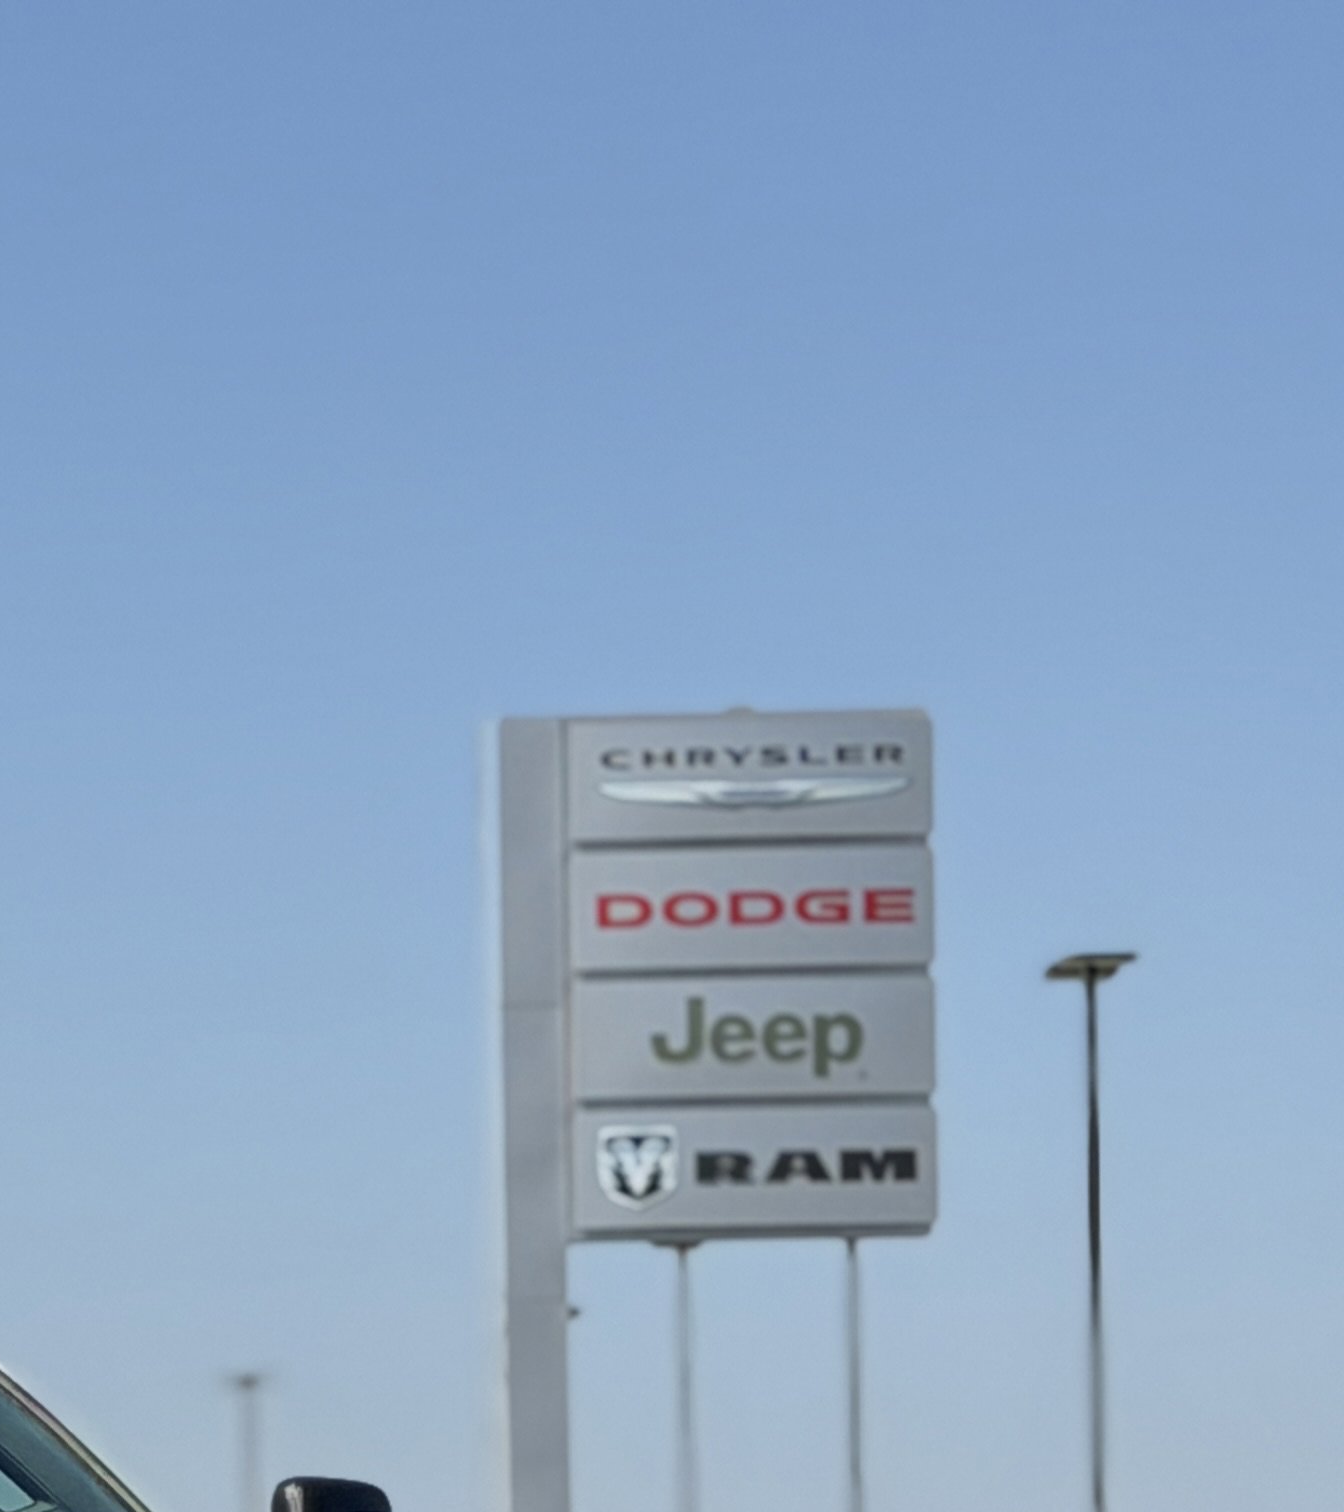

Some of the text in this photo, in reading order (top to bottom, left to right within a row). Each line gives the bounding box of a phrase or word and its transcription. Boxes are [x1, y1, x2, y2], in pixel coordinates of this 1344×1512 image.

[600, 744, 905, 771] CHRYSLER
[596, 888, 916, 928] DODGE
[650, 996, 864, 1077] Jeep
[695, 1149, 918, 1184] RAM
